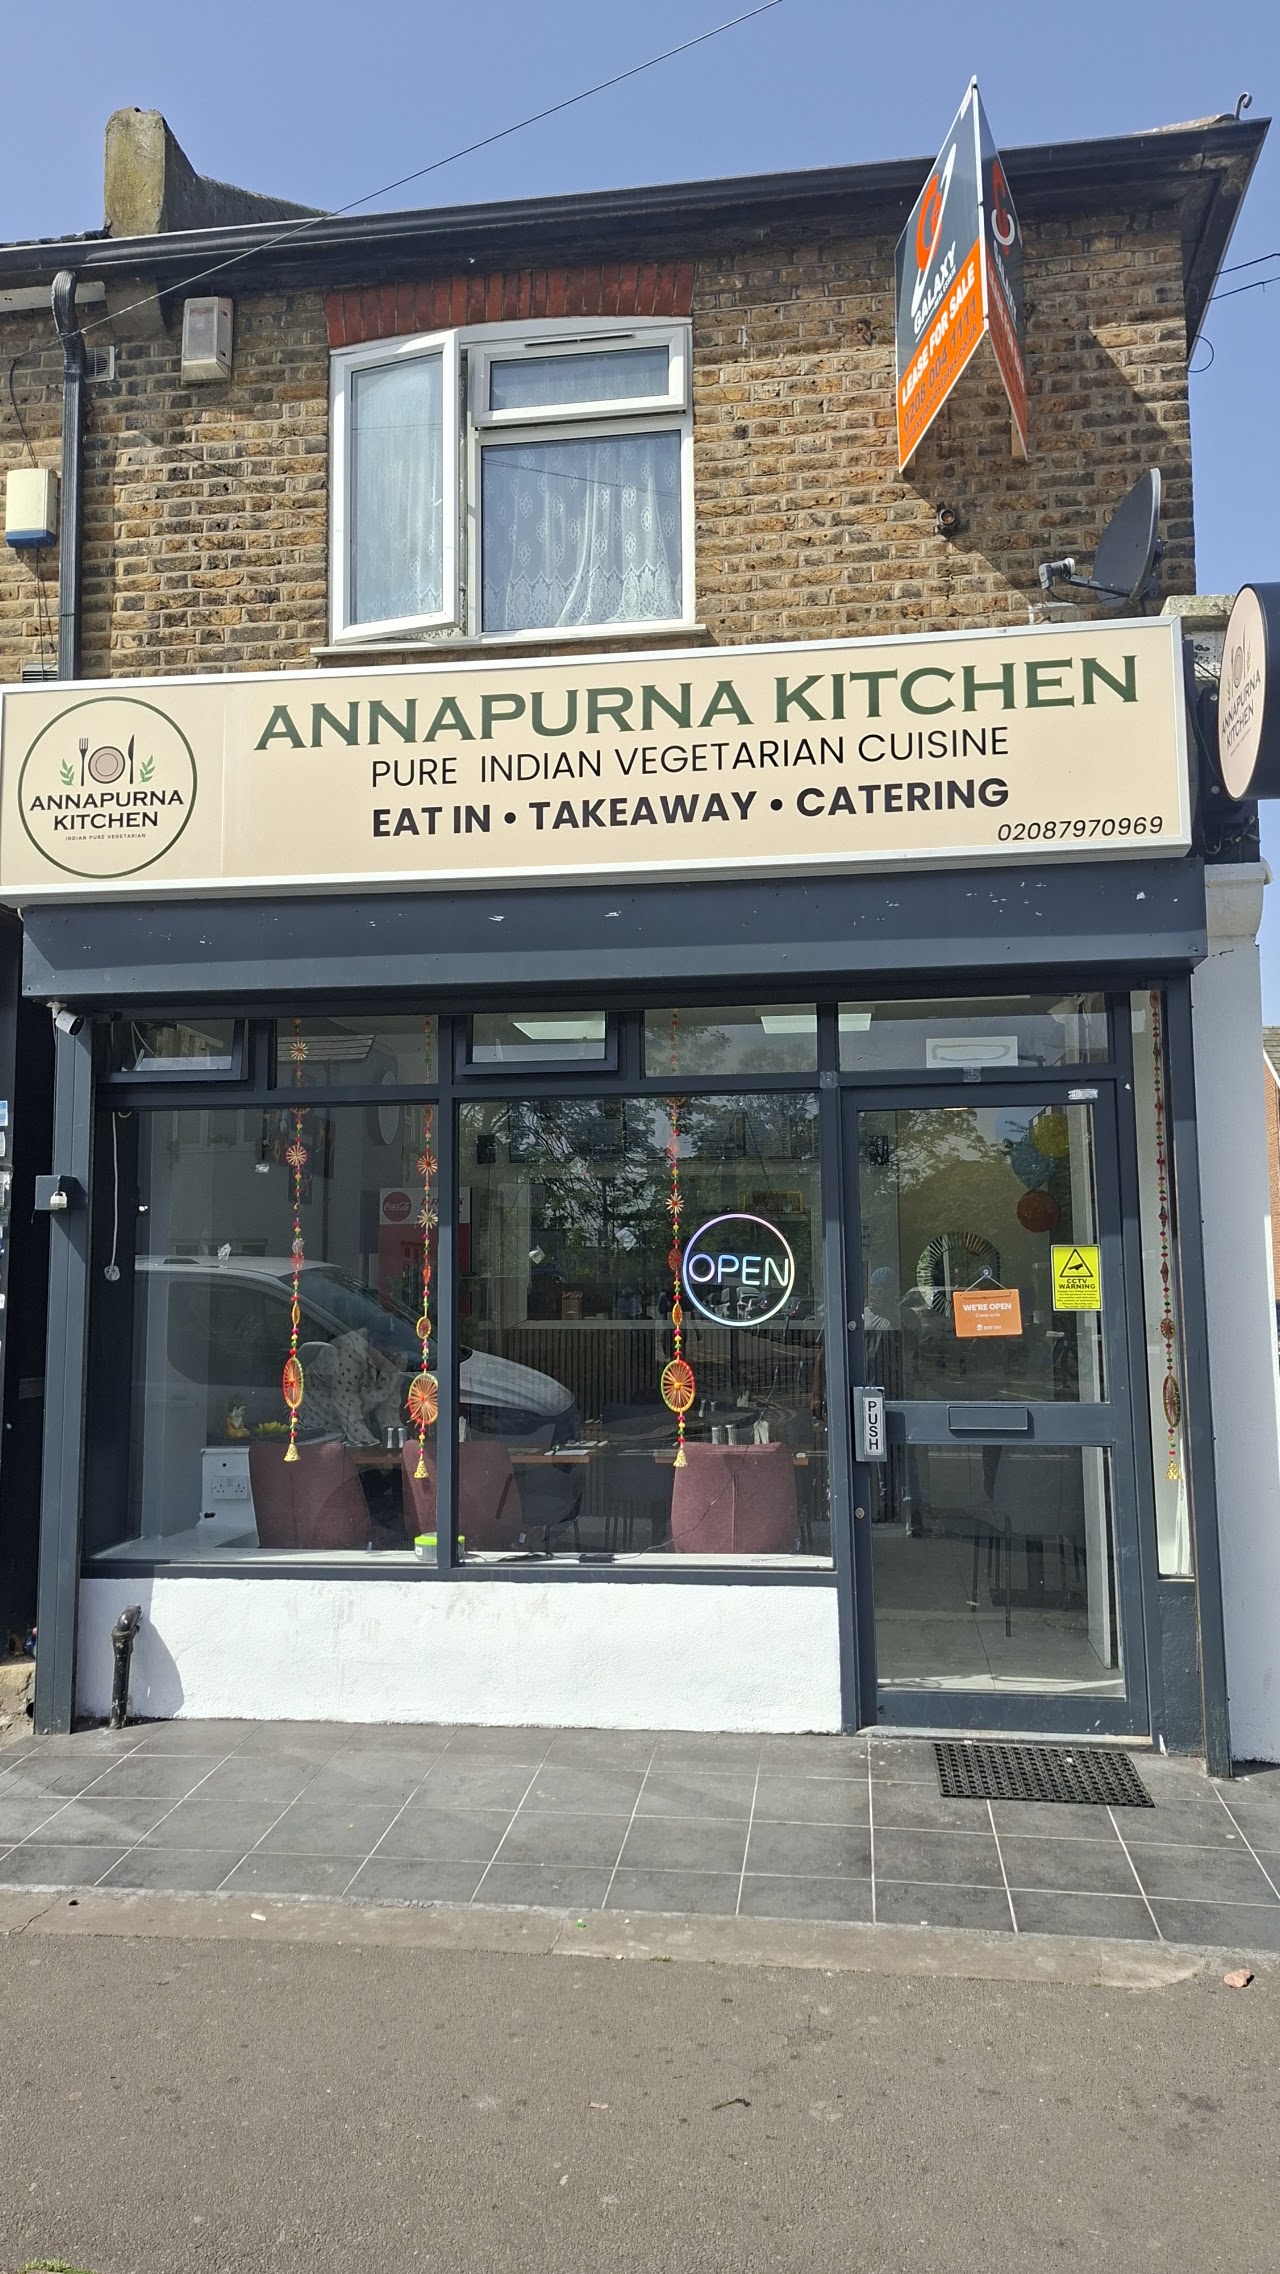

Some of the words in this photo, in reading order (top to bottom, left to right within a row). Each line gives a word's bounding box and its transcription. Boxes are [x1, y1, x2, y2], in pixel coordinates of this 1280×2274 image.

[914, 240, 956, 334] GALAXY
[902, 345, 930, 407] LEASE
[929, 310, 949, 357] FOR
[949, 261, 975, 320] SALE
[904, 384, 926, 432] 0208
[928, 343, 948, 389] 004
[951, 293, 977, 349] 1111
[253, 679, 755, 751] ANNAPURNA
[773, 654, 1140, 724] KITCHEN
[1221, 668, 1262, 738] ANNAPURNA
[1226, 699, 1254, 750] KITCHEN
[371, 757, 458, 788] PURE
[481, 749, 602, 783] INDIAN
[613, 736, 844, 777] VEGETARIAN
[857, 726, 1009, 763] CUISINE
[29, 789, 185, 812] ANNAPURNA
[53, 811, 158, 831] KITCHEN
[372, 806, 443, 837] EAT
[453, 804, 491, 834] IN
[528, 790, 758, 830] TAKEAWAY
[796, 777, 1009, 817] CATERING
[997, 815, 1164, 842] 02087970969
[688, 1253, 789, 1287] OPEN
[962, 1303, 988, 1312] WE'RE
[988, 1302, 1012, 1310] OPEN
[867, 1400, 879, 1450] PUSH
